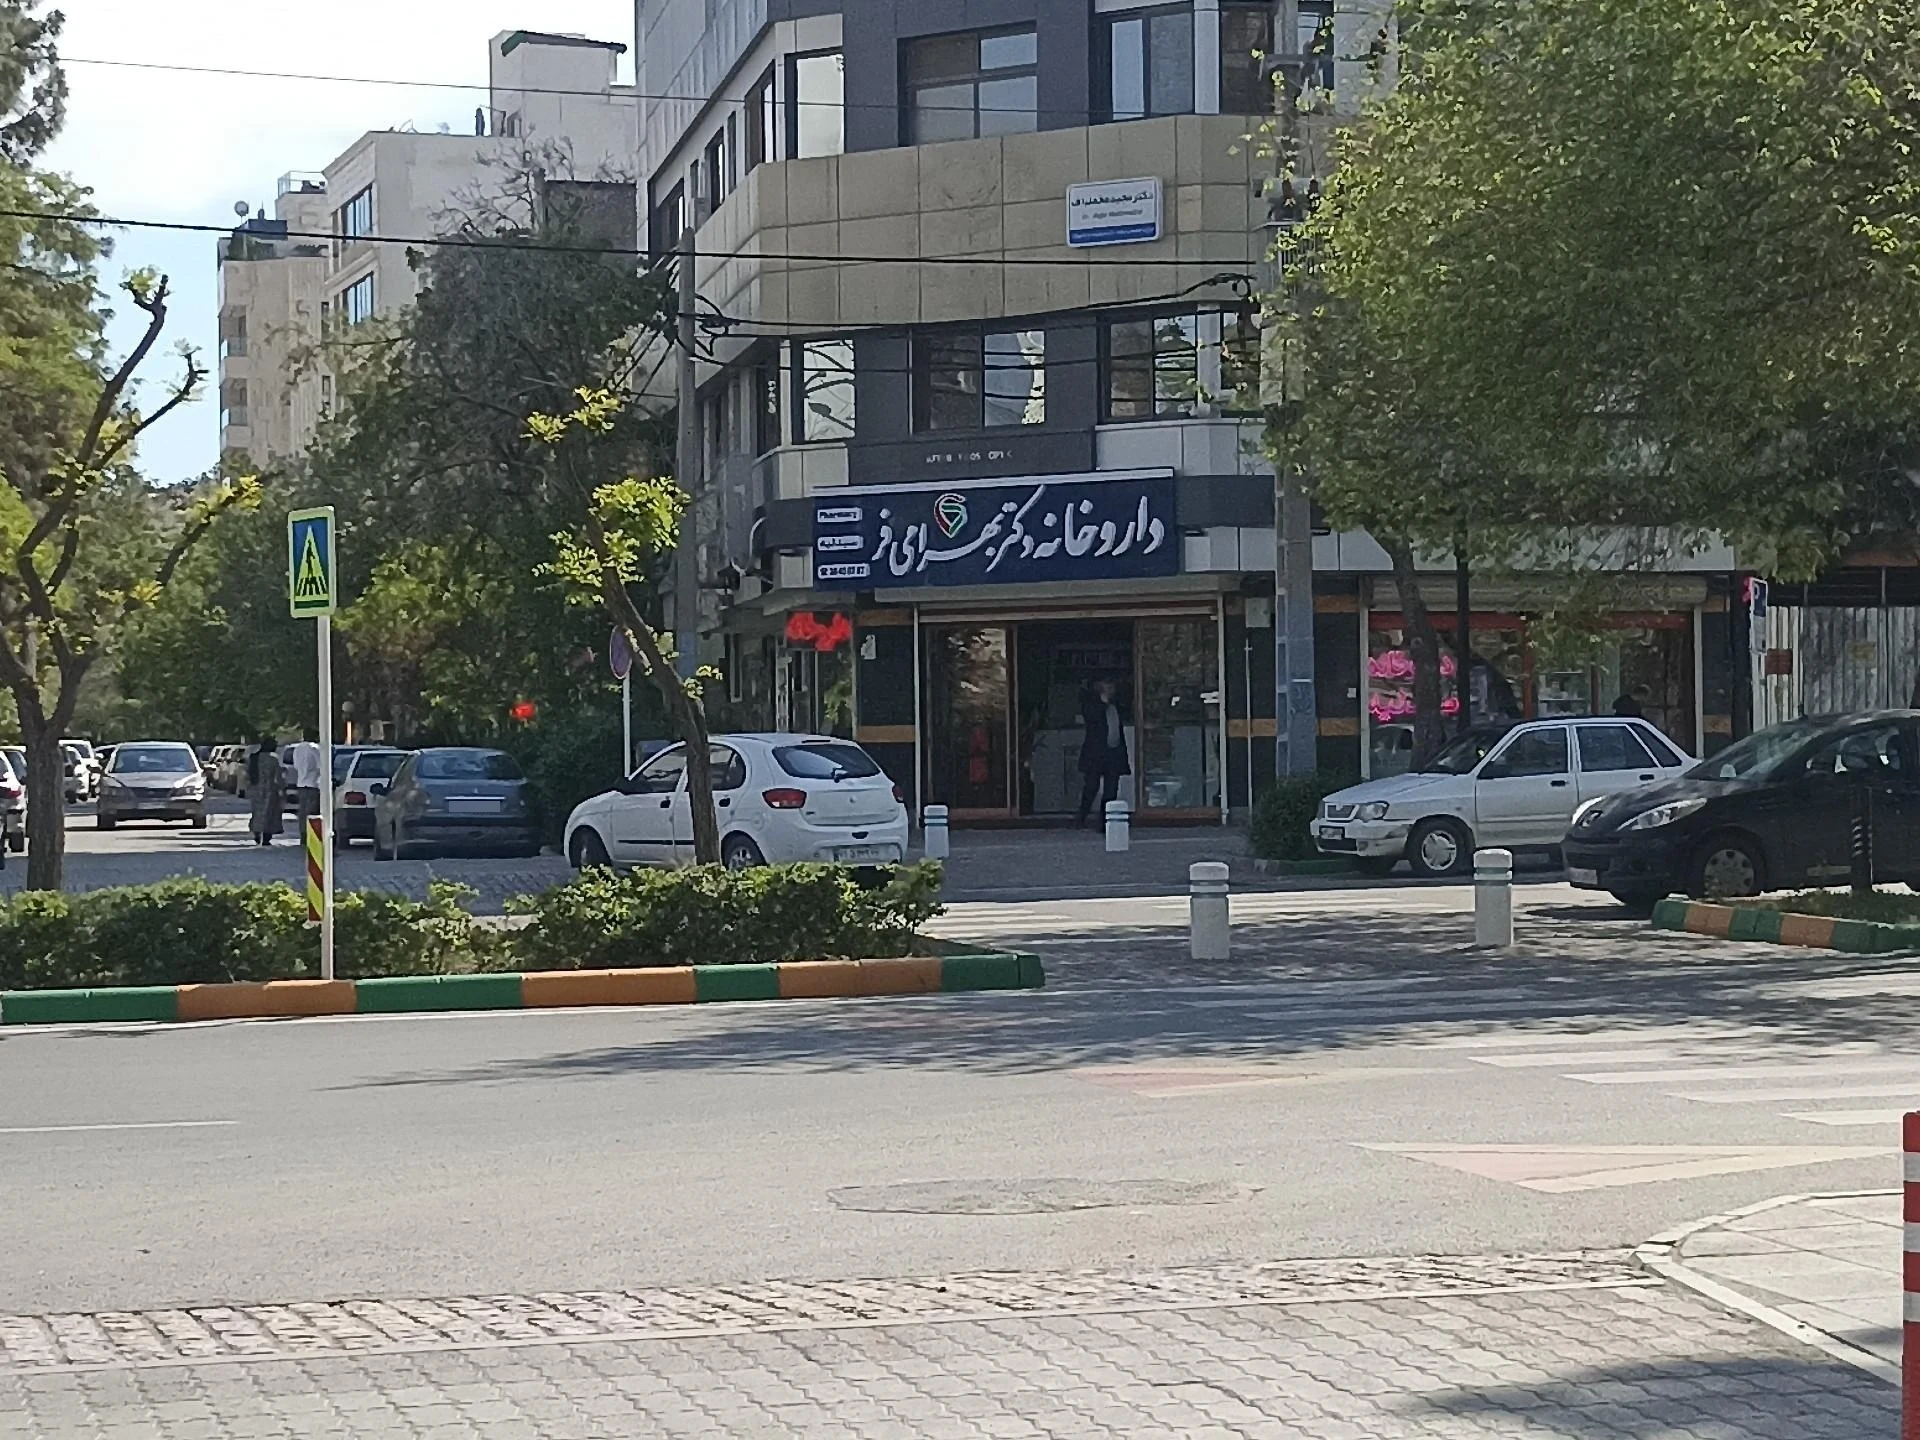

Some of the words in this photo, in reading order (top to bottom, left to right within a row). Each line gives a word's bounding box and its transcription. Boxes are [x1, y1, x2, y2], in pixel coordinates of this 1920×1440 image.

[872, 508, 894, 560] فر
[985, 485, 1046, 573] دکتر
[1033, 495, 1165, 558] داروخانه
